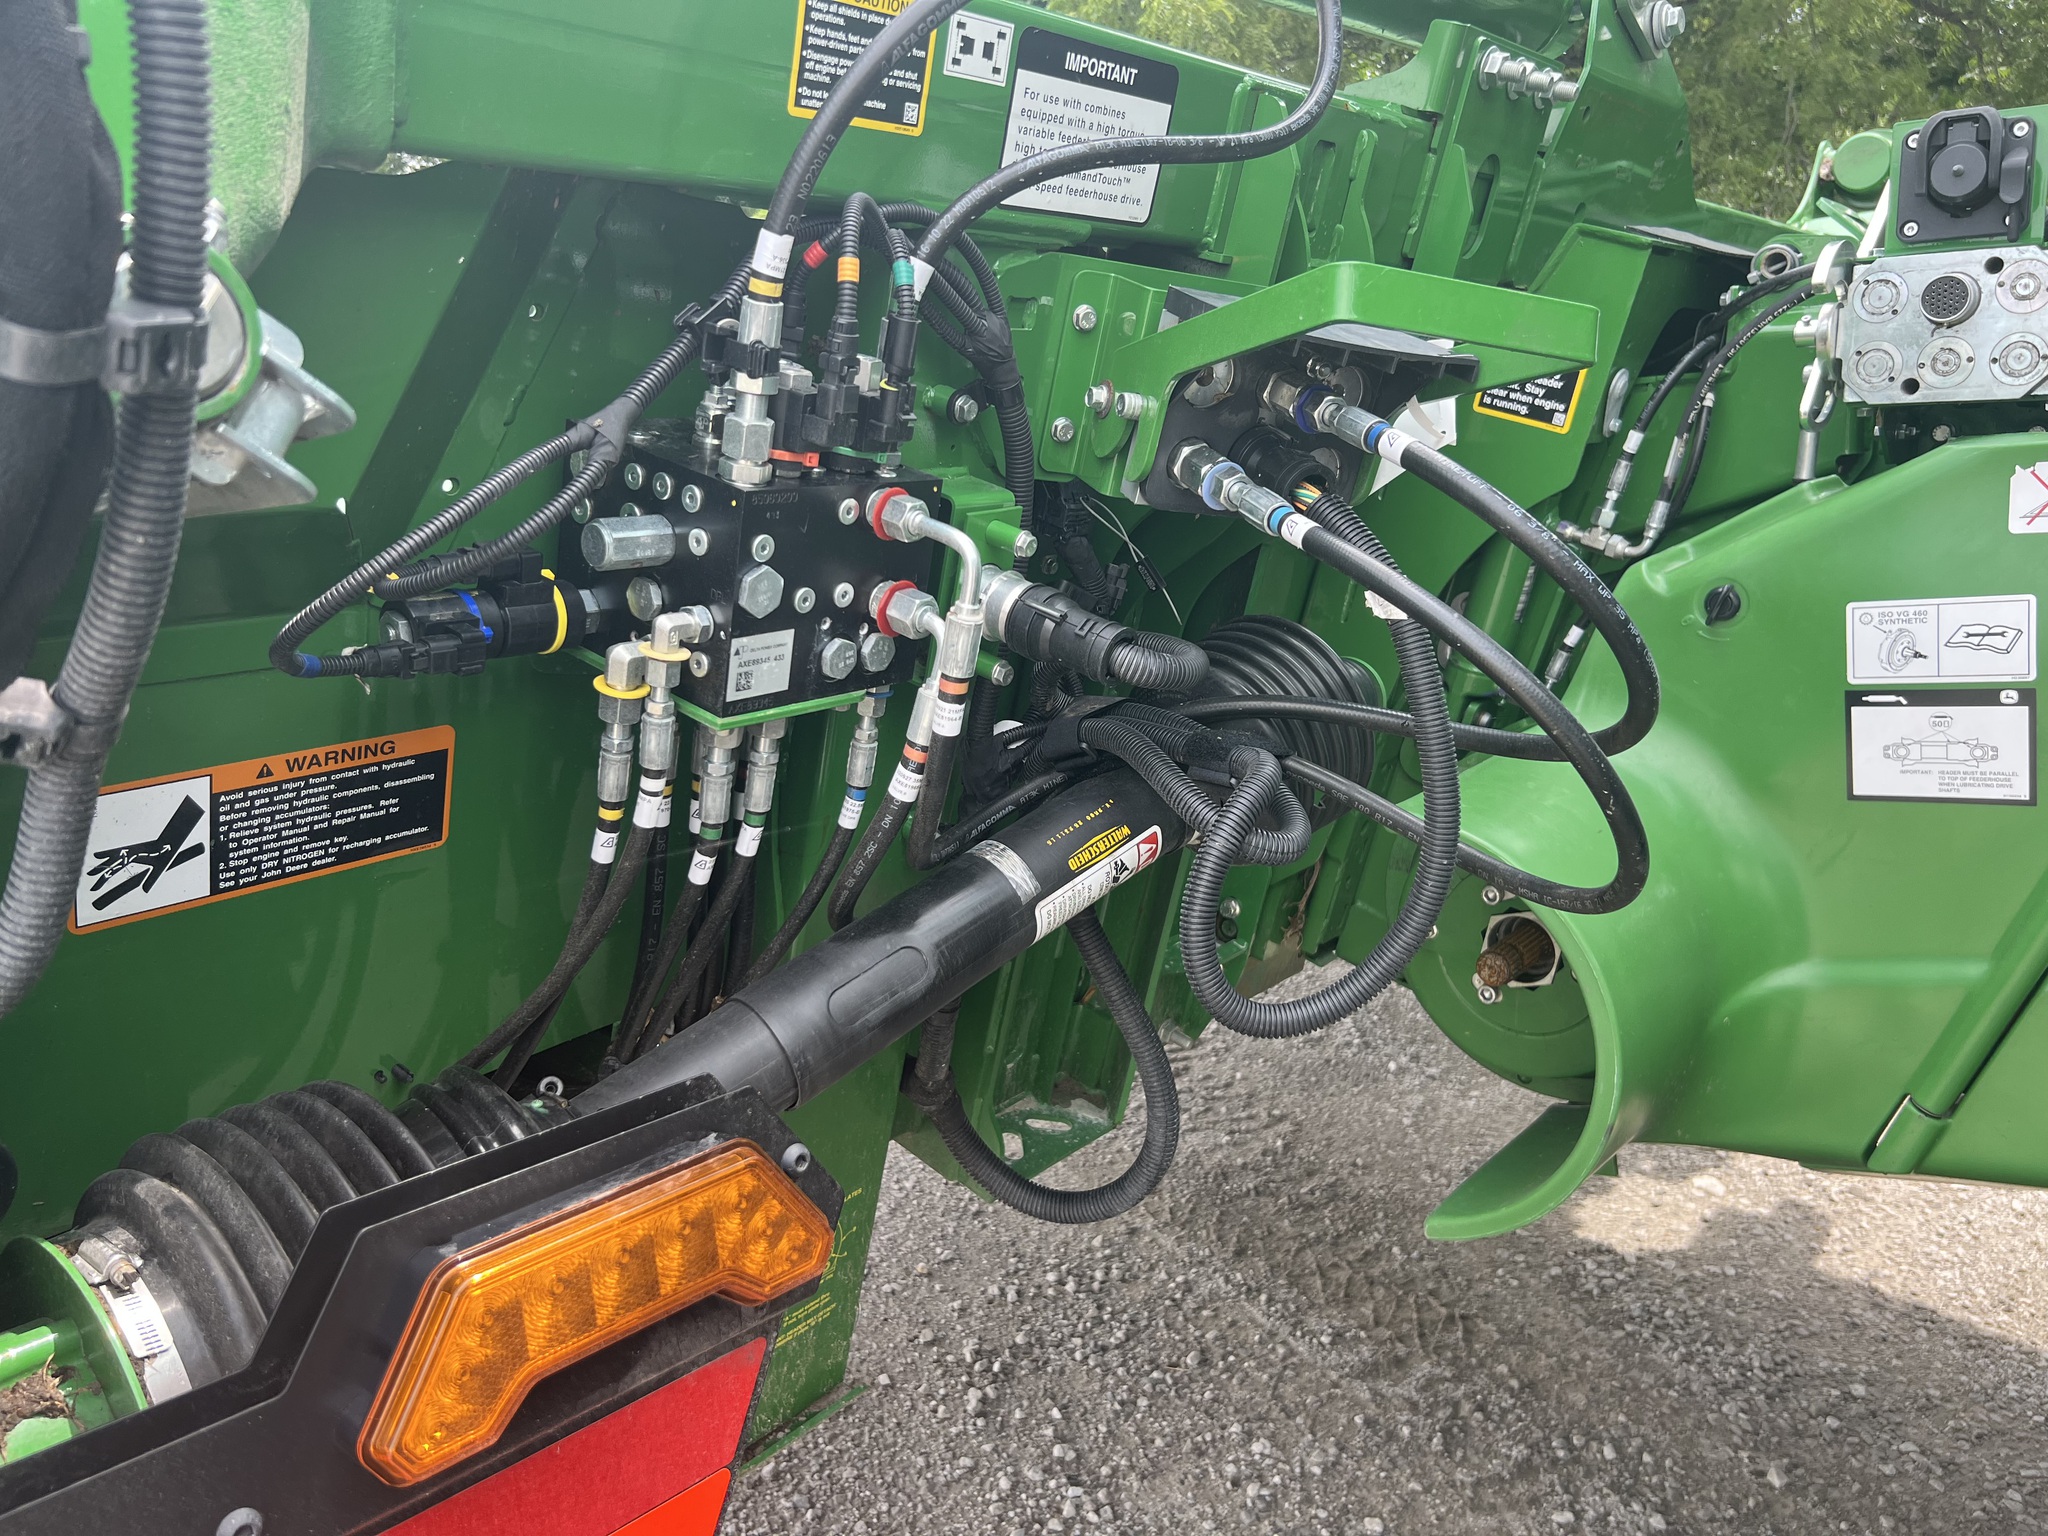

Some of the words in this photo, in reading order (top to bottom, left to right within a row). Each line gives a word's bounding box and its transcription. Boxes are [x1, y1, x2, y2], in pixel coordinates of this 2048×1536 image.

[810, 11, 846, 26] operations.
[812, 0, 828, 12] Keep
[838, 5, 860, 18] shields
[860, 10, 868, 20] in
[868, 12, 884, 25] place
[810, 24, 826, 37] Keep
[826, 28, 847, 42] hands,
[848, 32, 860, 43] feet
[806, 50, 838, 66] Disengage
[808, 36, 848, 52] power-driven
[912, 48, 926, 58] from
[804, 72, 832, 84] machine.
[805, 61, 814, 70] off
[815, 63, 836, 76] engine
[894, 69, 905, 78] and
[905, 70, 918, 81] shut
[1064, 51, 1138, 86] IMPORTANT
[802, 86, 811, 96] Do
[812, 89, 822, 98] not
[889, 78, 896, 86] or
[896, 79, 922, 93] servicing
[1023, 86, 1040, 101] For
[1042, 94, 1060, 106] use
[1062, 96, 1082, 111] with
[1084, 102, 1126, 120] combines
[1018, 124, 1055, 142] variable
[1020, 106, 1064, 126] equipped
[1067, 115, 1086, 130] with
[1088, 120, 1094, 130] a
[1096, 122, 1116, 138] high
[1014, 140, 1036, 156] high
[1065, 184, 1118, 203] feederhouse
[1120, 190, 1144, 207] drive.
[786, 214, 798, 233] 23
[1509, 390, 1533, 404] when
[1534, 398, 1565, 412] engine
[1524, 383, 1546, 398] Stay
[1482, 395, 1492, 404] is
[1492, 398, 1530, 416] running.
[1507, 502, 1522, 518] 06
[1572, 560, 1595, 583] MAX
[1597, 584, 1612, 600] WP
[1614, 603, 1626, 620] 35
[1628, 622, 1642, 644] MPa
[1878, 616, 1928, 626] SYNTHETIC
[285, 740, 396, 773] WARNING
[220, 792, 244, 802] Avoid
[248, 784, 279, 797] serious
[282, 780, 306, 792] injury
[309, 774, 328, 784] from
[331, 769, 360, 781] contact
[363, 765, 378, 774] with
[382, 758, 416, 772] hydraulic
[219, 811, 248, 822] Before
[251, 802, 290, 816] removing
[293, 790, 329, 808] hydraulic
[332, 784, 380, 800] components,
[384, 773, 435, 789] disassembling
[219, 804, 230, 812] oil
[234, 800, 250, 810] and
[254, 797, 270, 808] gas
[274, 791, 297, 802] under
[301, 784, 338, 797] pressure.
[219, 824, 228, 832] or
[232, 814, 271, 829] changing
[274, 804, 330, 820] accumulators:
[220, 834, 227, 842] 1.
[229, 827, 260, 840] Relieve
[263, 818, 292, 832] system
[296, 810, 332, 824] hydraulic
[335, 803, 375, 818] pressures.
[380, 797, 400, 807] Refer
[882, 814, 894, 828] DN
[970, 804, 1017, 840] ALFAGOMMA
[1331, 789, 1350, 802] SAE
[1354, 800, 1370, 815] 100
[1374, 812, 1393, 827] R17
[1408, 831, 1420, 842] EN
[229, 841, 238, 849] to
[242, 832, 278, 846] Operator
[282, 826, 310, 837] Manual
[314, 821, 328, 830] and
[332, 816, 356, 828] Repair
[360, 809, 386, 820] Manual
[390, 806, 400, 814] for
[219, 870, 236, 880] Use
[240, 865, 258, 876] only
[261, 860, 280, 870] DRY
[282, 850, 325, 865] NITROGEN
[328, 845, 339, 854] for
[342, 836, 382, 852] recharging
[384, 826, 430, 842] accumulator.
[229, 846, 259, 859] system
[262, 836, 310, 850] information.
[229, 858, 249, 870] Stop
[252, 850, 280, 864] engine
[284, 846, 299, 855] and
[302, 839, 331, 850] remove
[334, 834, 349, 845] key.
[864, 840, 878, 858] 2SC
[1066, 824, 1132, 872] WALTERSCHEID
[218, 880, 236, 890] See
[238, 874, 258, 886] your
[261, 868, 282, 880] John
[286, 864, 309, 874] Deere
[312, 855, 338, 868] dealer.
[854, 859, 866, 876] 857
[654, 870, 665, 892] 857
[845, 876, 856, 888] EN
[1518, 887, 1539, 901] MSHA
[652, 902, 663, 916] EN
